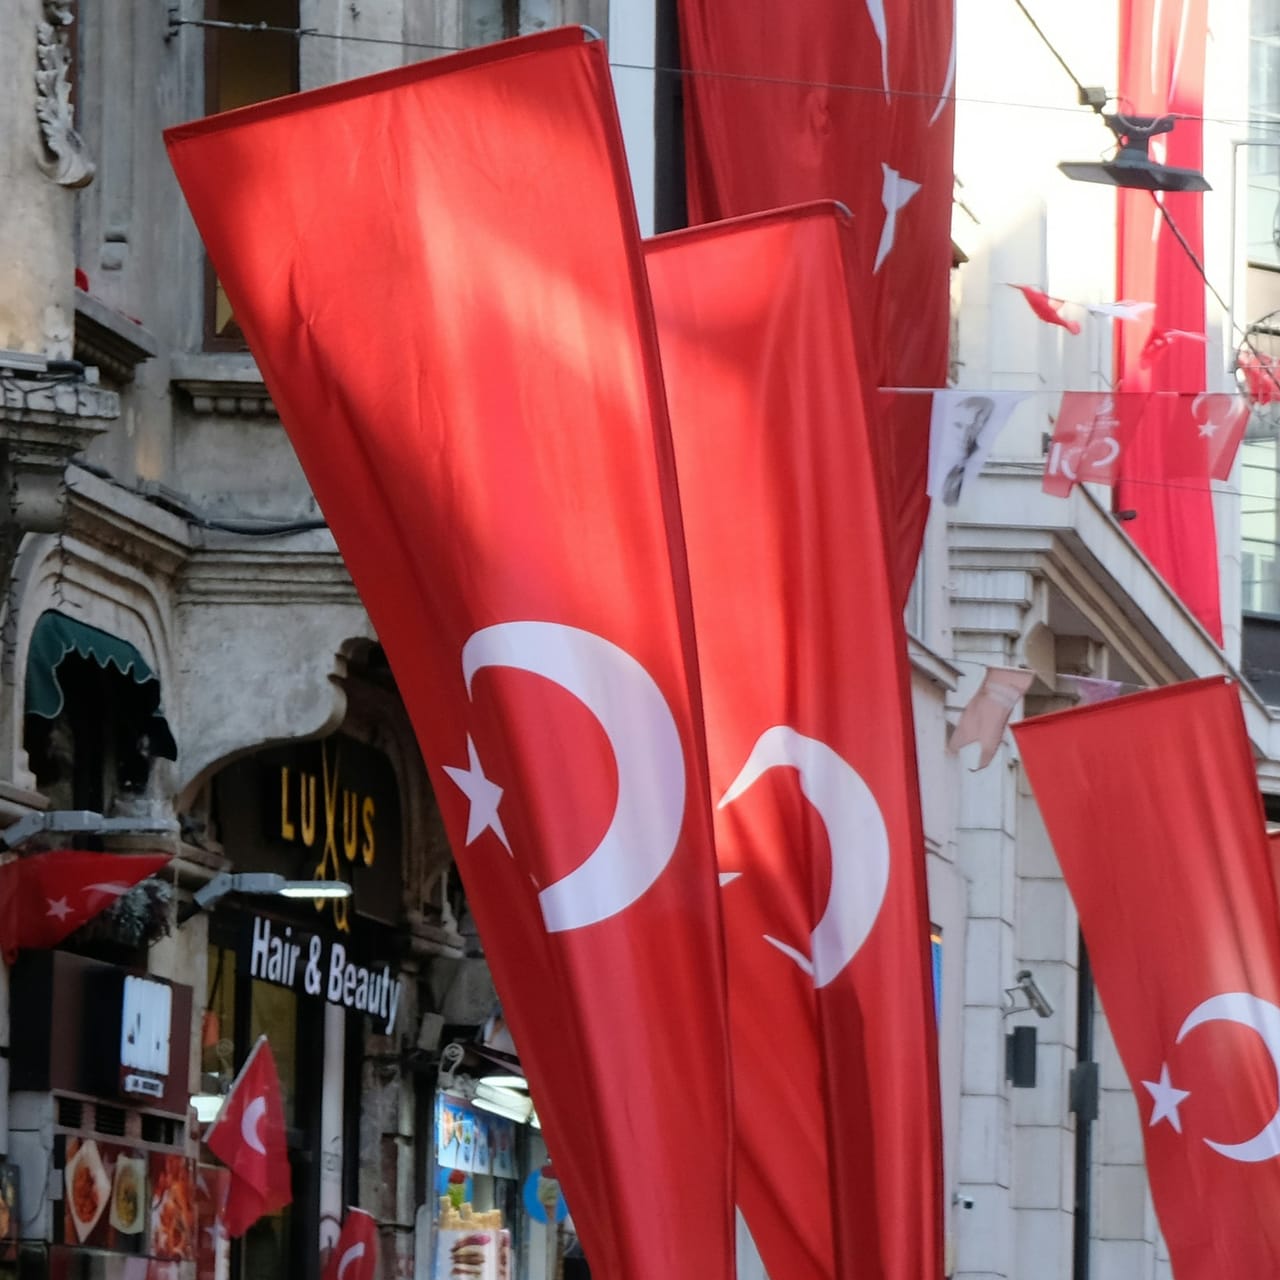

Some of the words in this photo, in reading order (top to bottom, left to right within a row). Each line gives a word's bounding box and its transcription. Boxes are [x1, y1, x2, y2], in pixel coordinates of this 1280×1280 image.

[250, 916, 300, 987] Hair
[304, 934, 322, 996] &
[327, 942, 401, 1036] Beauty
